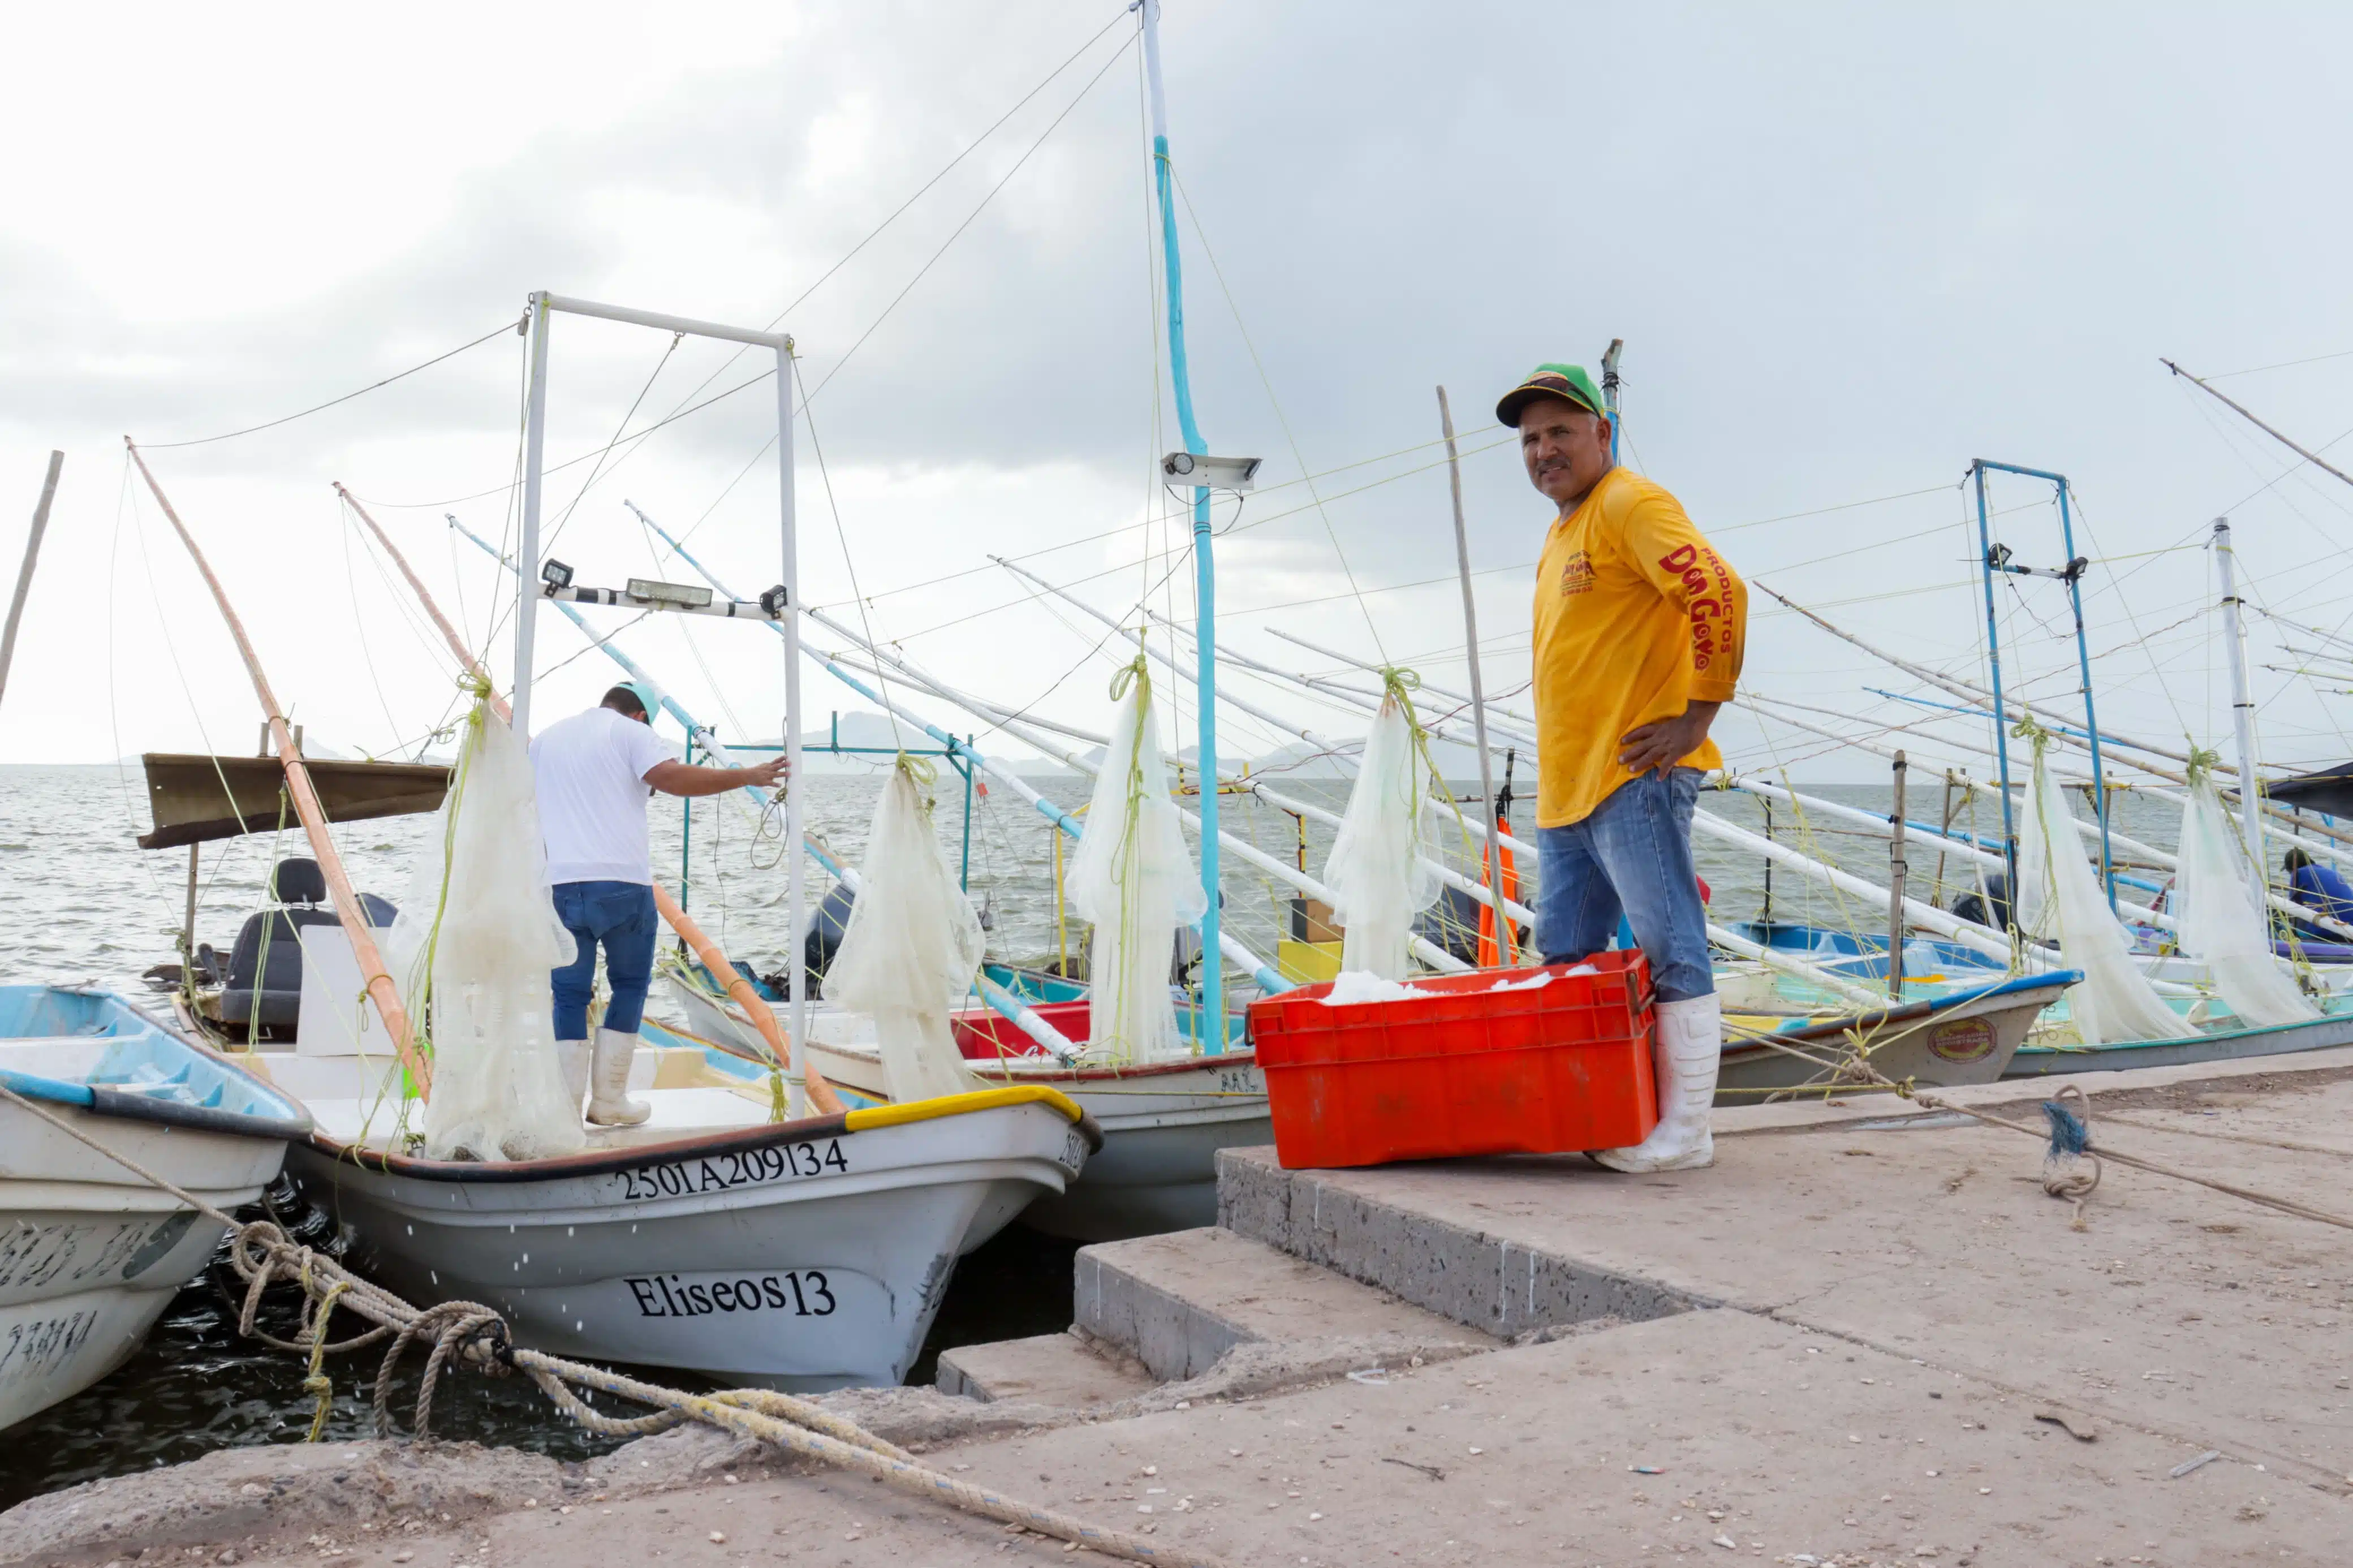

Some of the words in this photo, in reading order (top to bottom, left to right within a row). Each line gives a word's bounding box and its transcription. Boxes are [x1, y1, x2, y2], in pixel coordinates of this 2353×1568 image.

[1658, 544, 1708, 596] Don
[1700, 547, 1734, 654] PRODUCTOS
[614, 1138, 848, 1200] 2501A209134
